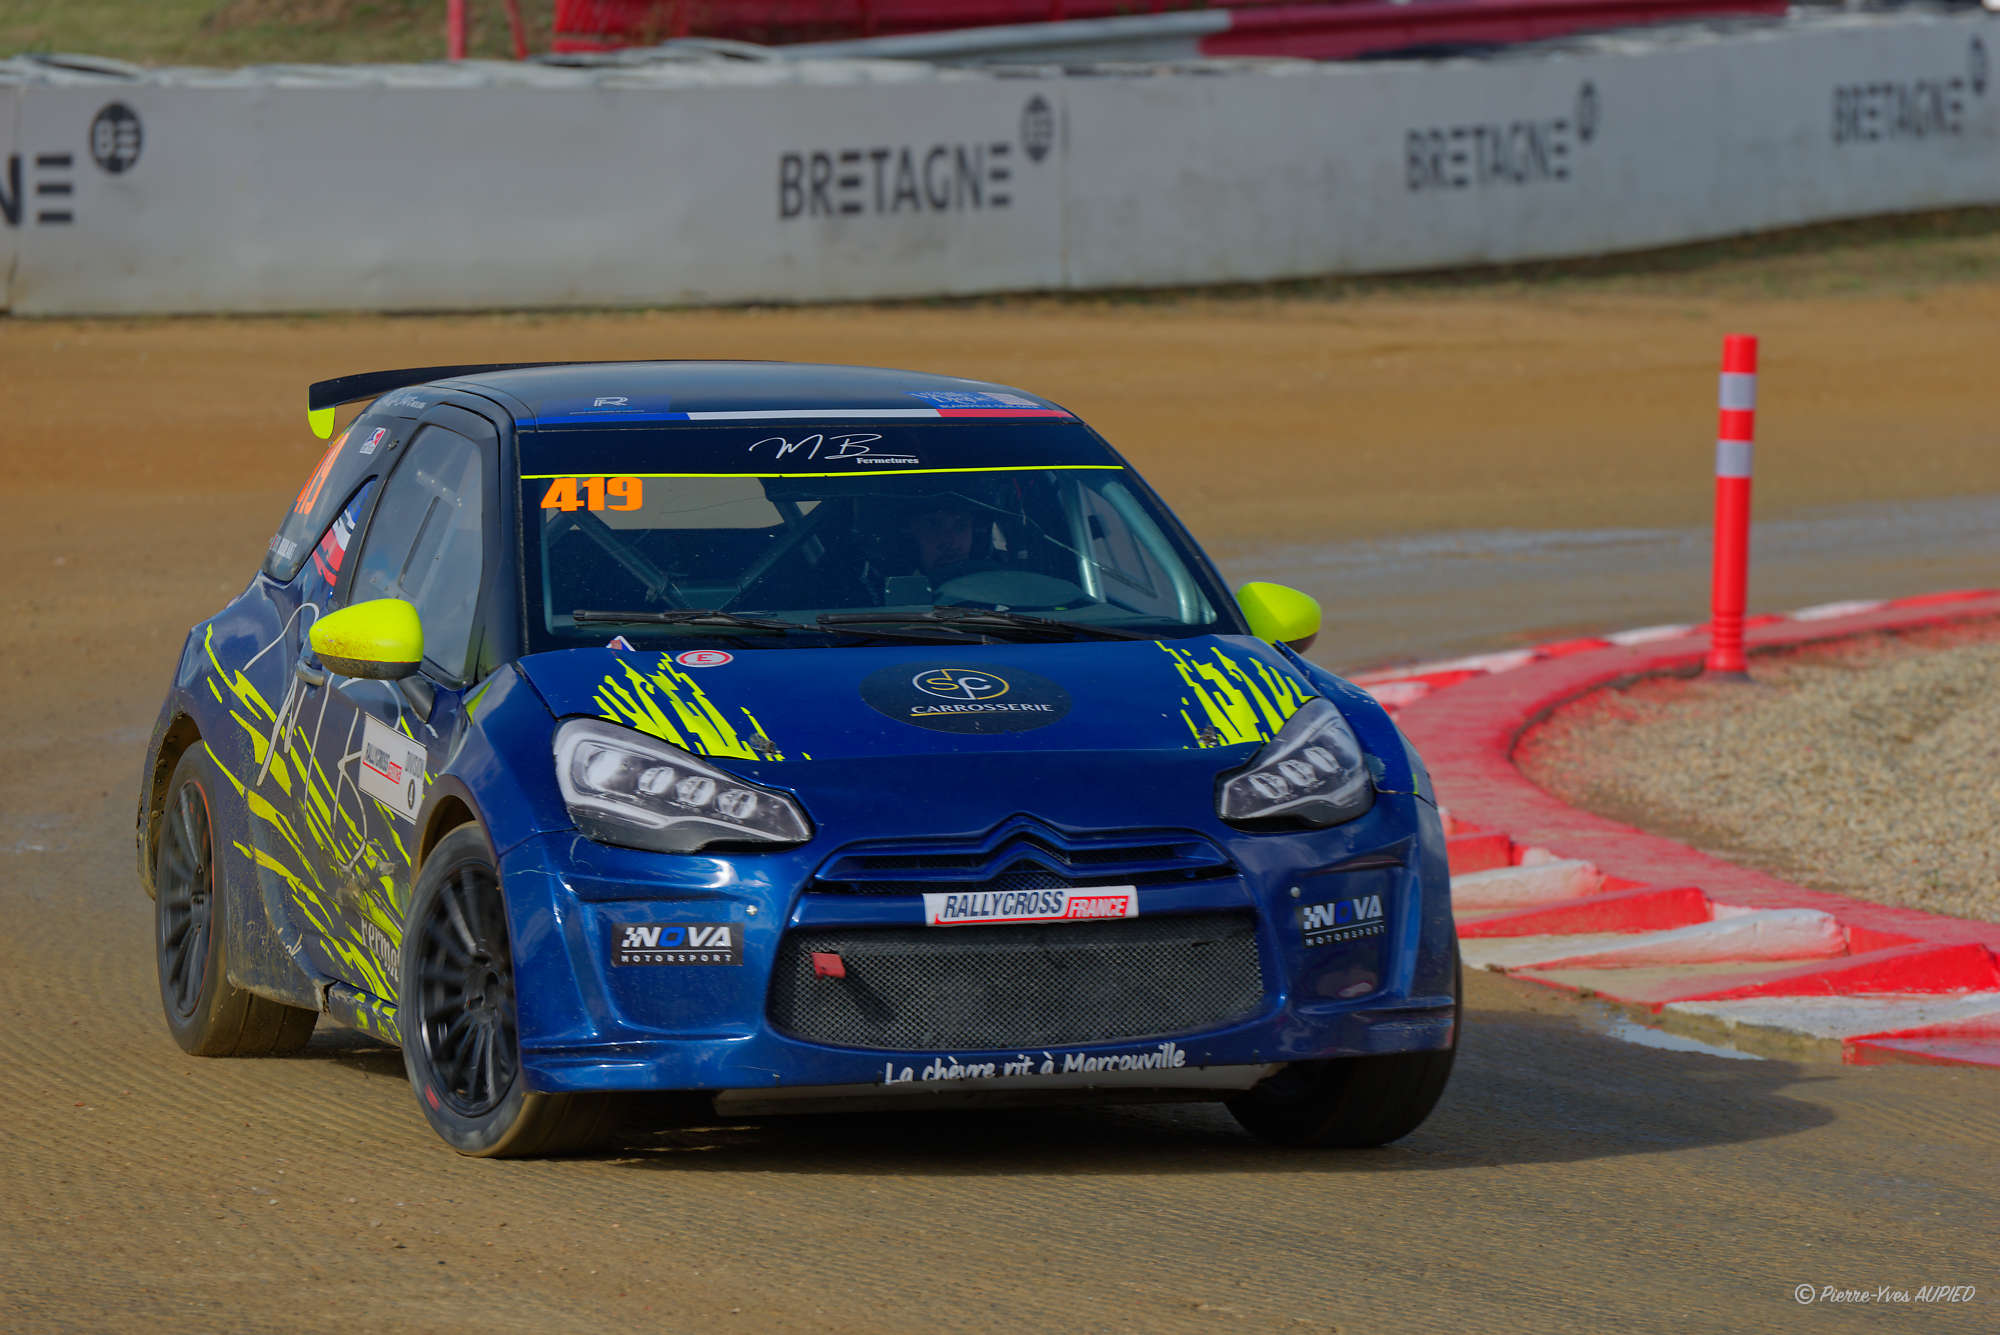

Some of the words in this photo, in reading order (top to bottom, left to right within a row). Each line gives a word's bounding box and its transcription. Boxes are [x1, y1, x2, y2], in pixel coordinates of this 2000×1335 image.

[1406, 119, 1569, 188] BRETAGNE
[779, 146, 1011, 218] BRETAGNE
[856, 457, 920, 465] Fermetures
[540, 476, 643, 512] 419
[911, 703, 1055, 714] CARROSSERIE
[943, 891, 1065, 918] RALLYCROSS
[1067, 898, 1127, 918] FRANCE
[1303, 895, 1384, 930] NOVA
[621, 926, 733, 948] NOVA
[620, 954, 733, 963] MOTORSPORT
[885, 1062, 914, 1085] La
[921, 1056, 996, 1081] chèvre
[1003, 1054, 1035, 1077] rit
[1040, 1051, 1055, 1075] à
